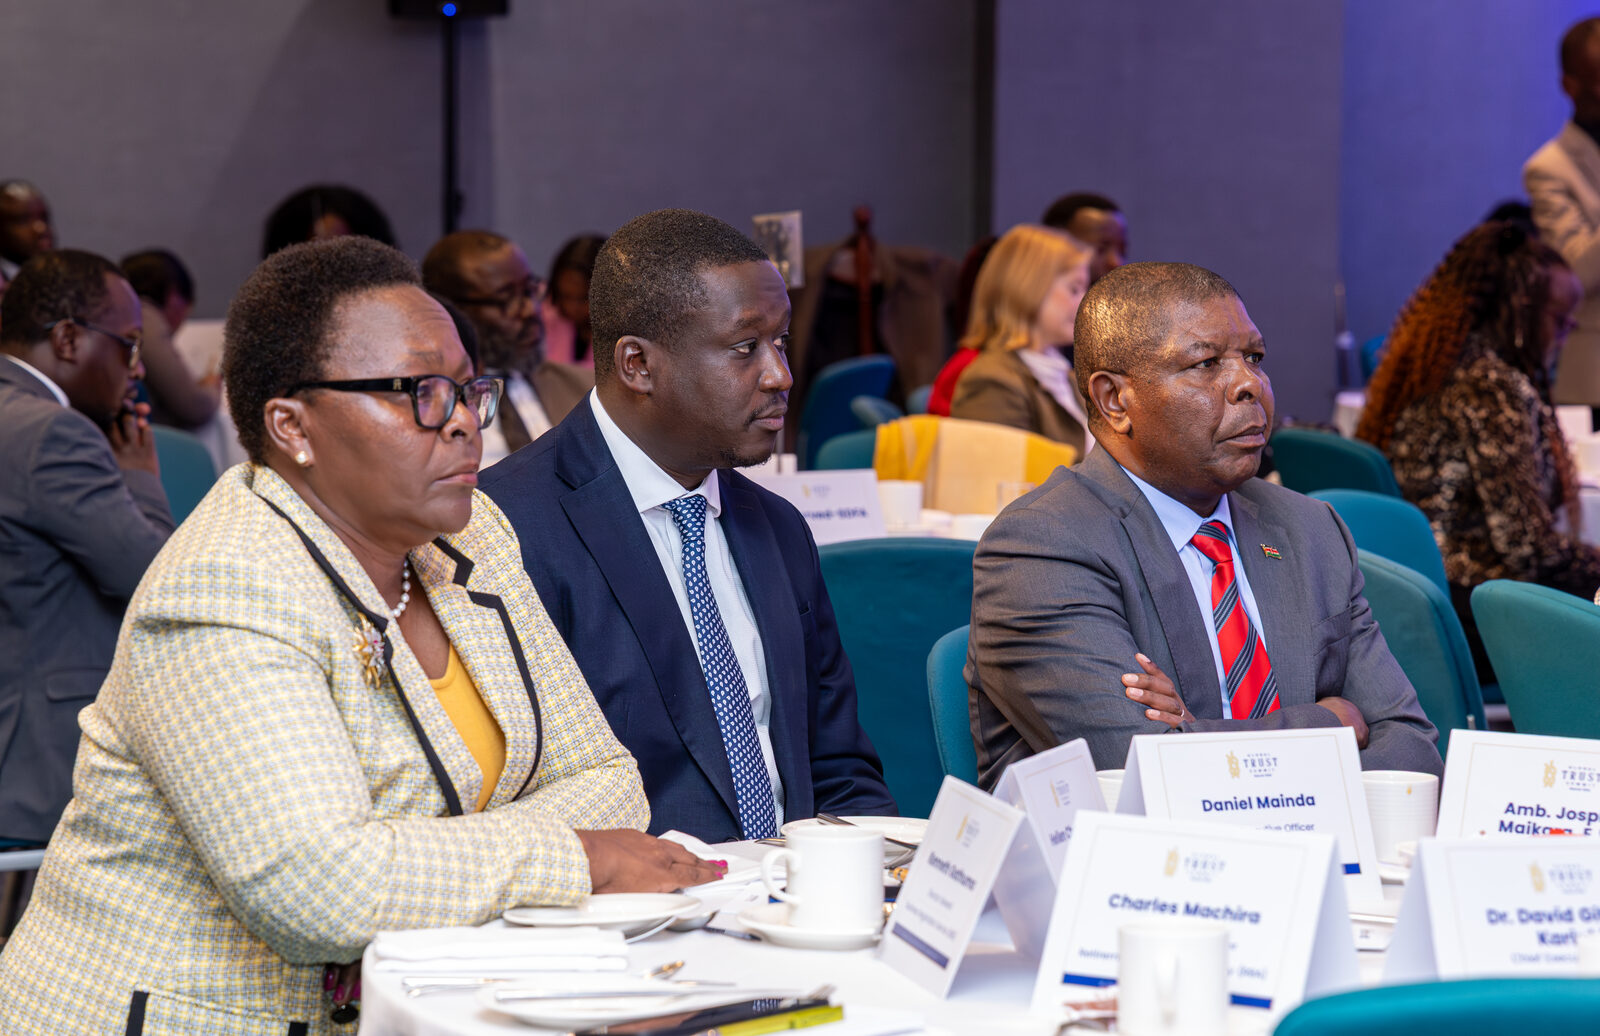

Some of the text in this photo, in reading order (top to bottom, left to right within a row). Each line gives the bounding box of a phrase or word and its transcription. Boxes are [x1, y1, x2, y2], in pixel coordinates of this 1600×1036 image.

[1243, 757, 1278, 768] TRUST
[1562, 769, 1600, 783] TRUST
[1202, 793, 1316, 812] Daniel Mainda
[1504, 801, 1600, 827] Amb. Josp
[1108, 893, 1261, 923] Charles Machira
[1486, 907, 1514, 926] Dr.
[1517, 905, 1575, 925] David
